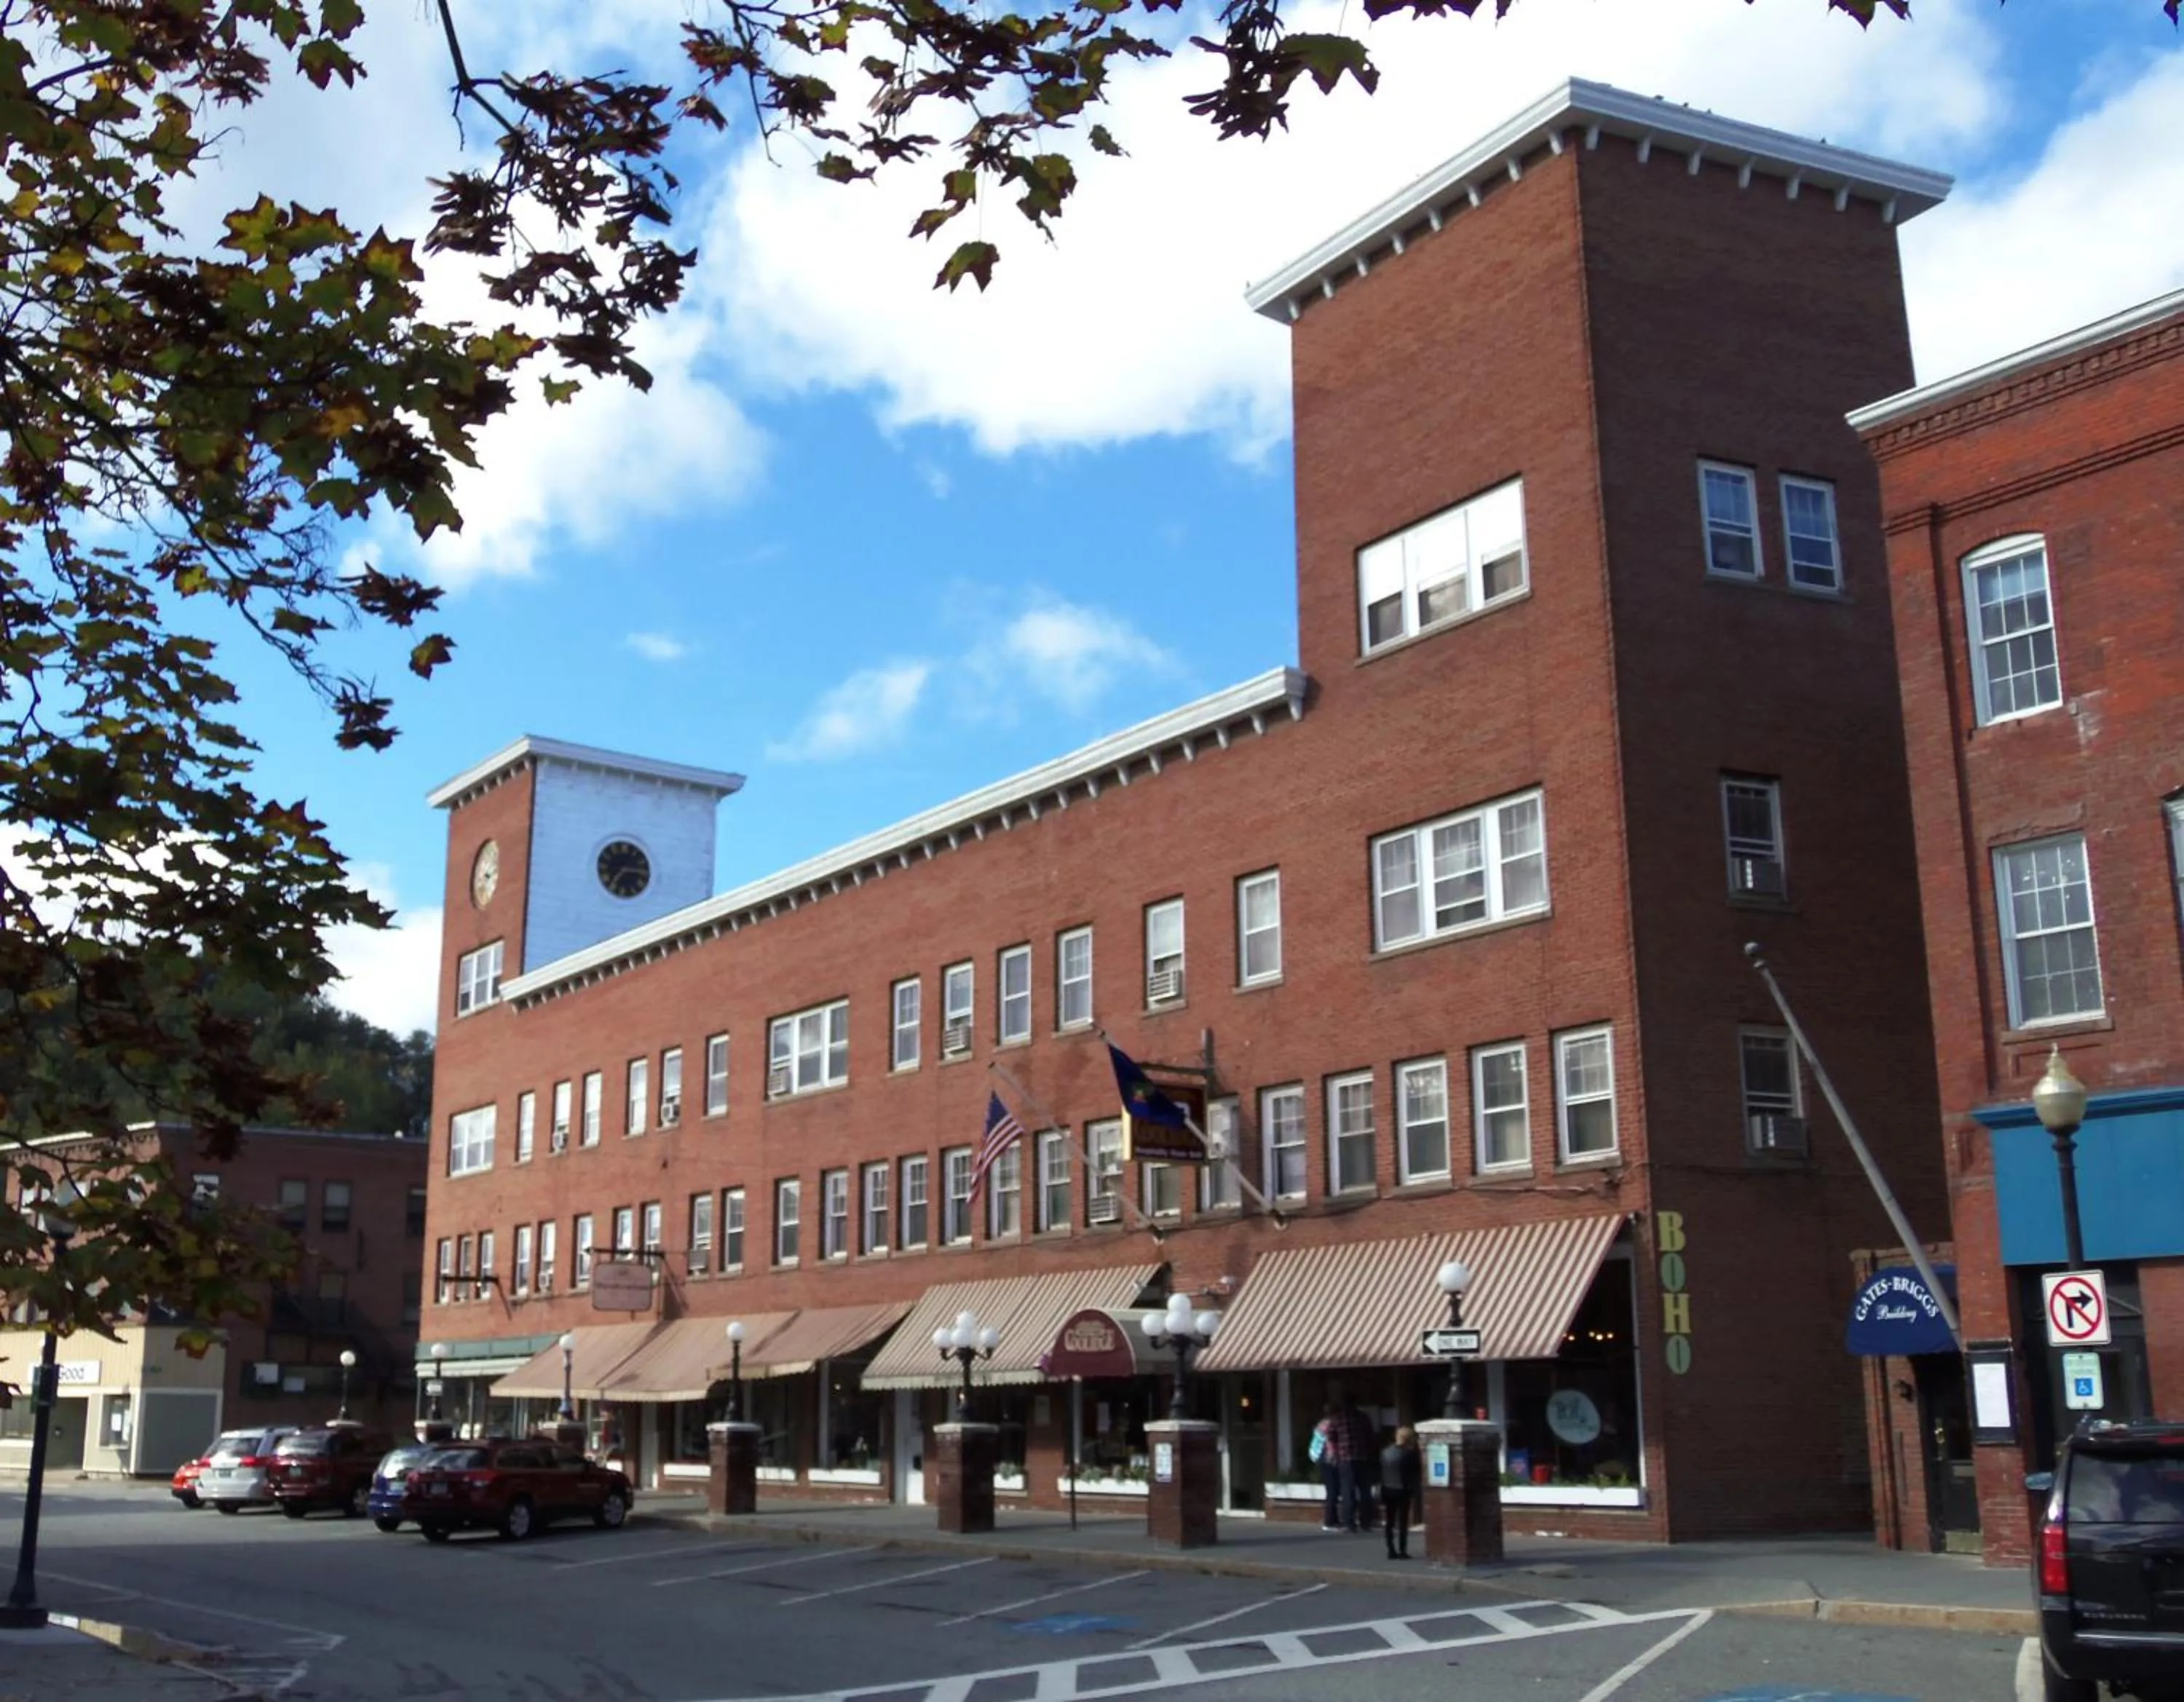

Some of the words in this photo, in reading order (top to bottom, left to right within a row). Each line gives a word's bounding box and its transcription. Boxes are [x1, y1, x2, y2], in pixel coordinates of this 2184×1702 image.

[1657, 1211, 1691, 1375] BOHO
[1856, 1276, 1939, 1321] GATES-BRIGGS
[1876, 1304, 1917, 1323] Building
[1457, 1337, 1473, 1347] WAY
